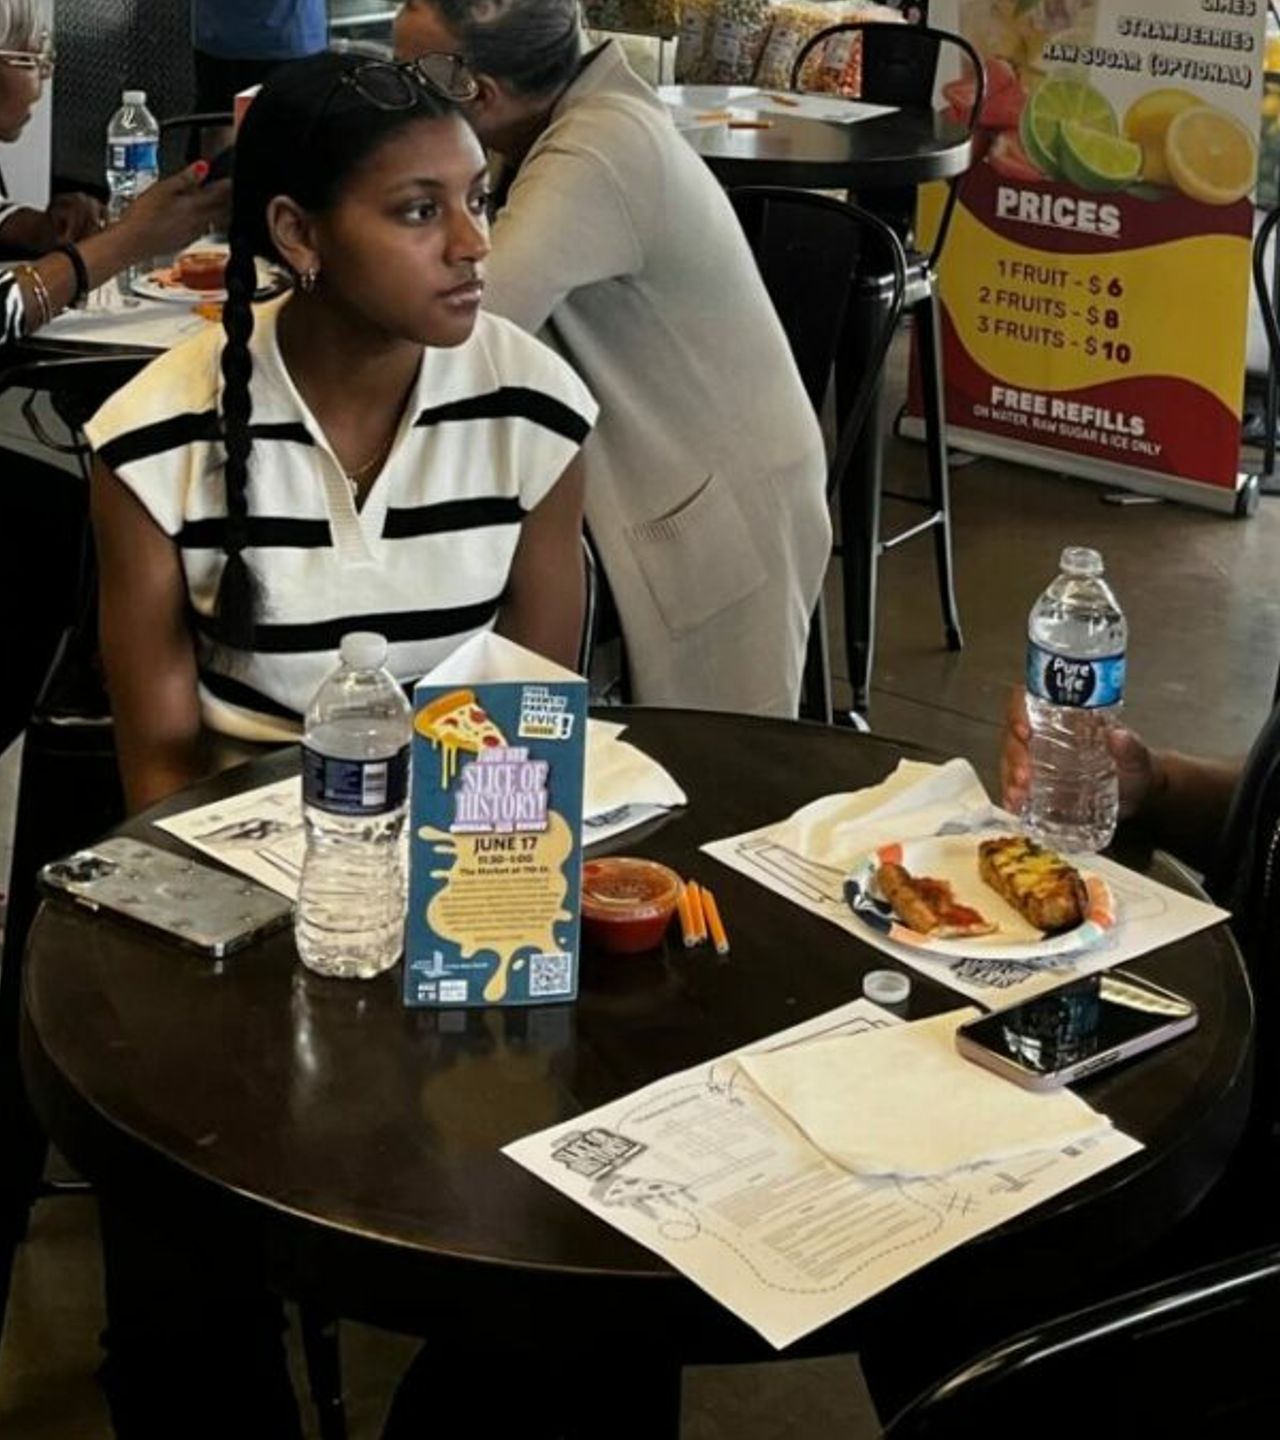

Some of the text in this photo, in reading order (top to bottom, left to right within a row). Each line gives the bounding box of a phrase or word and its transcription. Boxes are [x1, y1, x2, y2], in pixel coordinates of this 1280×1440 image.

[1116, 19, 1255, 51] STRAWBERRIES
[1042, 42, 1253, 90] RAW SUGAR (OPTIONAL)
[995, 185, 1122, 237] PRICES
[997, 259, 1007, 277] 1
[1010, 261, 1069, 289] FRUIT
[978, 286, 992, 305] 2
[994, 290, 1067, 319] FRUITS
[977, 315, 990, 334] 3
[993, 318, 1066, 350] FRUITS
[990, 385, 1145, 437] FREE REFILLS
[973, 403, 990, 419] ON
[1032, 416, 1057, 434] RAW
[1058, 422, 1098, 443] SUGAR
[1110, 433, 1129, 452] ICE
[1130, 438, 1162, 457] ONLY
[1052, 656, 1090, 678] Pure
[1055, 673, 1085, 692] Life
[522, 713, 559, 727] CIVIC
[461, 761, 549, 792] SLICE OF
[454, 790, 547, 821] HISTORY!
[473, 836, 539, 855] JUNE 17
[477, 865, 510, 875] Market
